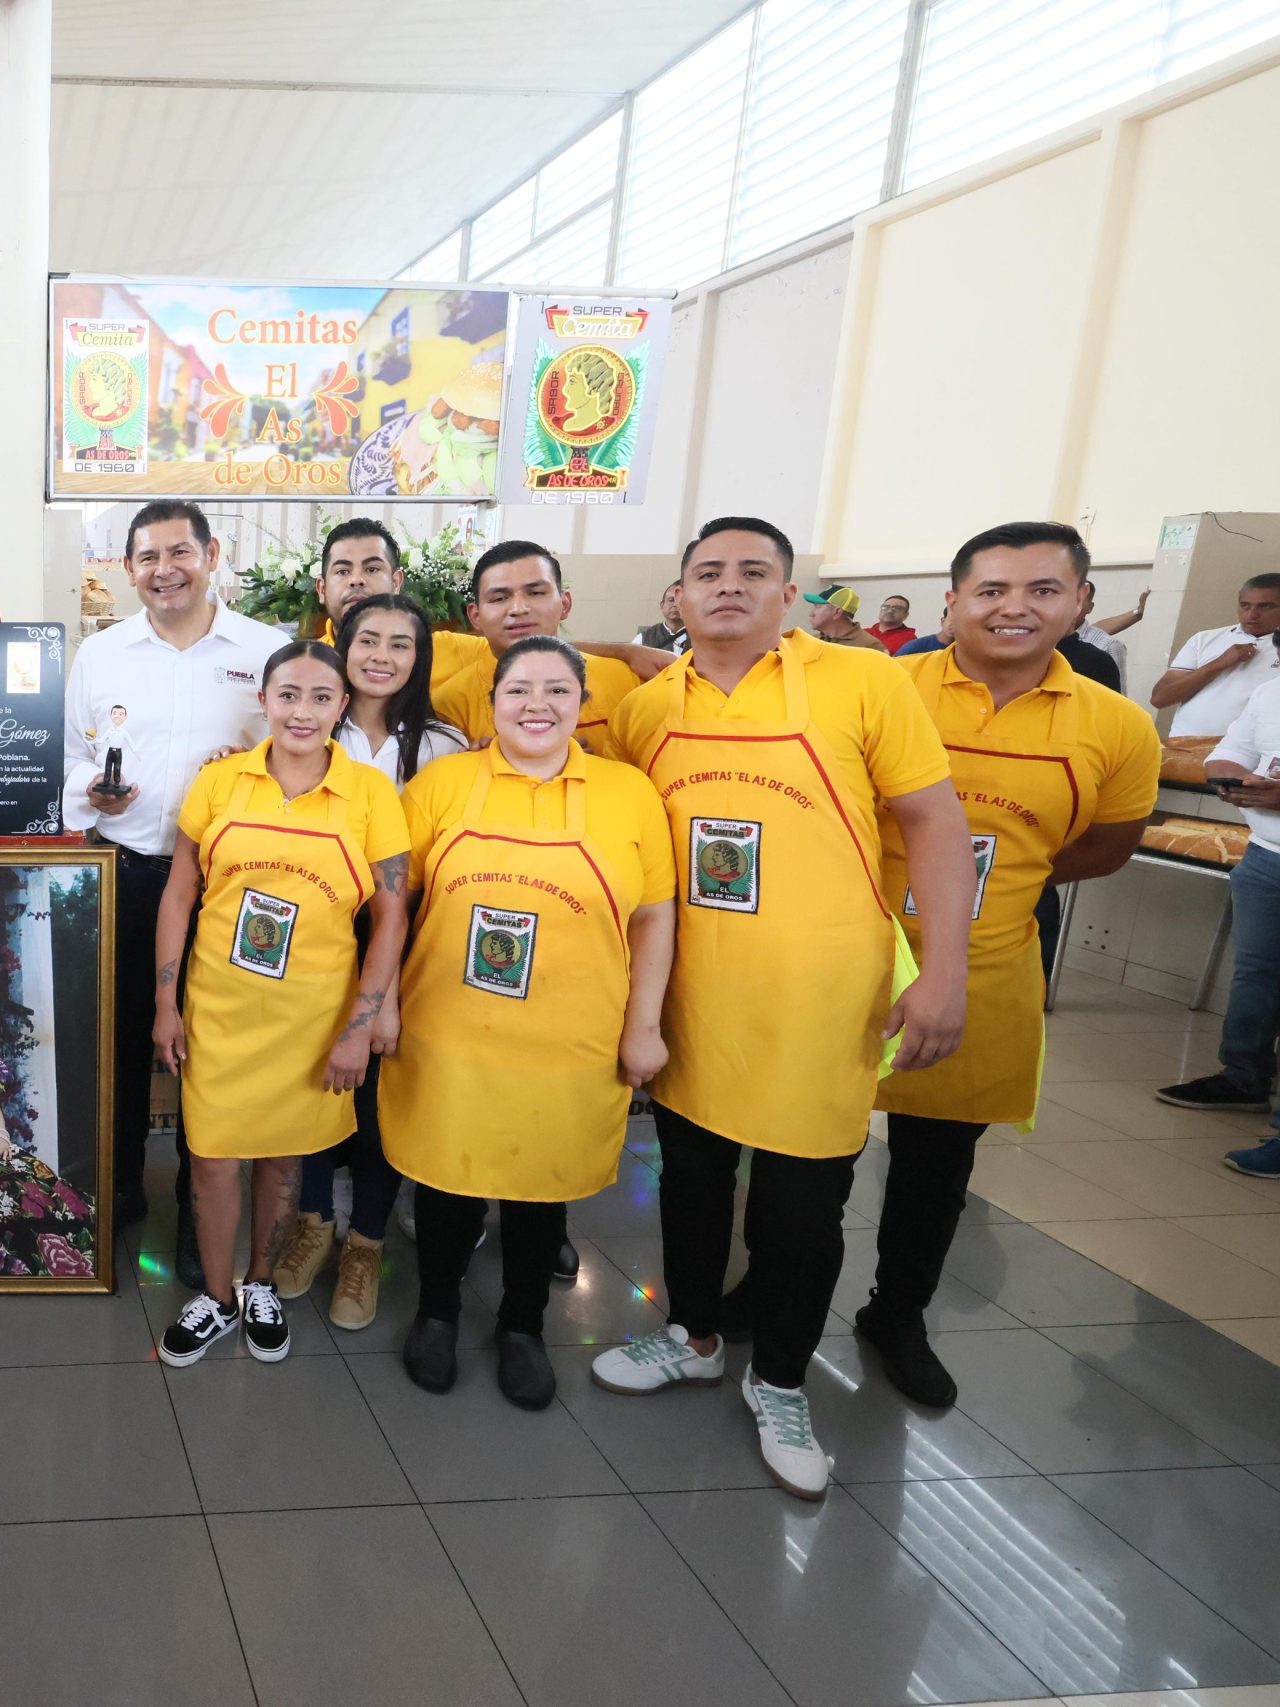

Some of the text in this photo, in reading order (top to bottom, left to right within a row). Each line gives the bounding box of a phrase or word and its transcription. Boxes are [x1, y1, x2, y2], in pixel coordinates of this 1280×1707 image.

[572, 305, 623, 316] SUPER
[88, 322, 125, 331] SUPER
[207, 308, 358, 346] Cemitas
[562, 316, 633, 338] Cemita
[82, 332, 134, 347] Cemita
[264, 362, 298, 399] El
[548, 370, 560, 415] SABOR
[256, 407, 302, 443] As
[85, 450, 129, 460] AS DE OROS
[74, 463, 135, 473] DE 1960
[214, 451, 341, 486] de Oros
[547, 474, 608, 487] AS DE OROS
[531, 492, 613, 505] DE 1960
[227, 670, 255, 680] PUEBLA
[5, 706, 12, 714] la
[661, 778, 686, 801] SUPER
[689, 771, 732, 784] CEMITAS
[734, 772, 749, 783] "EL
[752, 775, 766, 786] AS
[767, 779, 784, 792] DE
[971, 792, 989, 803] "EL
[990, 796, 1006, 808] AS
[1007, 801, 1021, 814] DE
[222, 863, 242, 878] SUPER
[244, 861, 280, 871] CEMITAS
[296, 867, 308, 878] AS
[308, 872, 321, 885] DE
[445, 875, 468, 894] SUPER
[471, 872, 512, 883] CEMITAS
[515, 874, 529, 886] "EL
[530, 878, 545, 889] AS
[544, 882, 560, 896] DE
[486, 917, 523, 929] CEMITAS
[495, 912, 516, 920] SUPER
